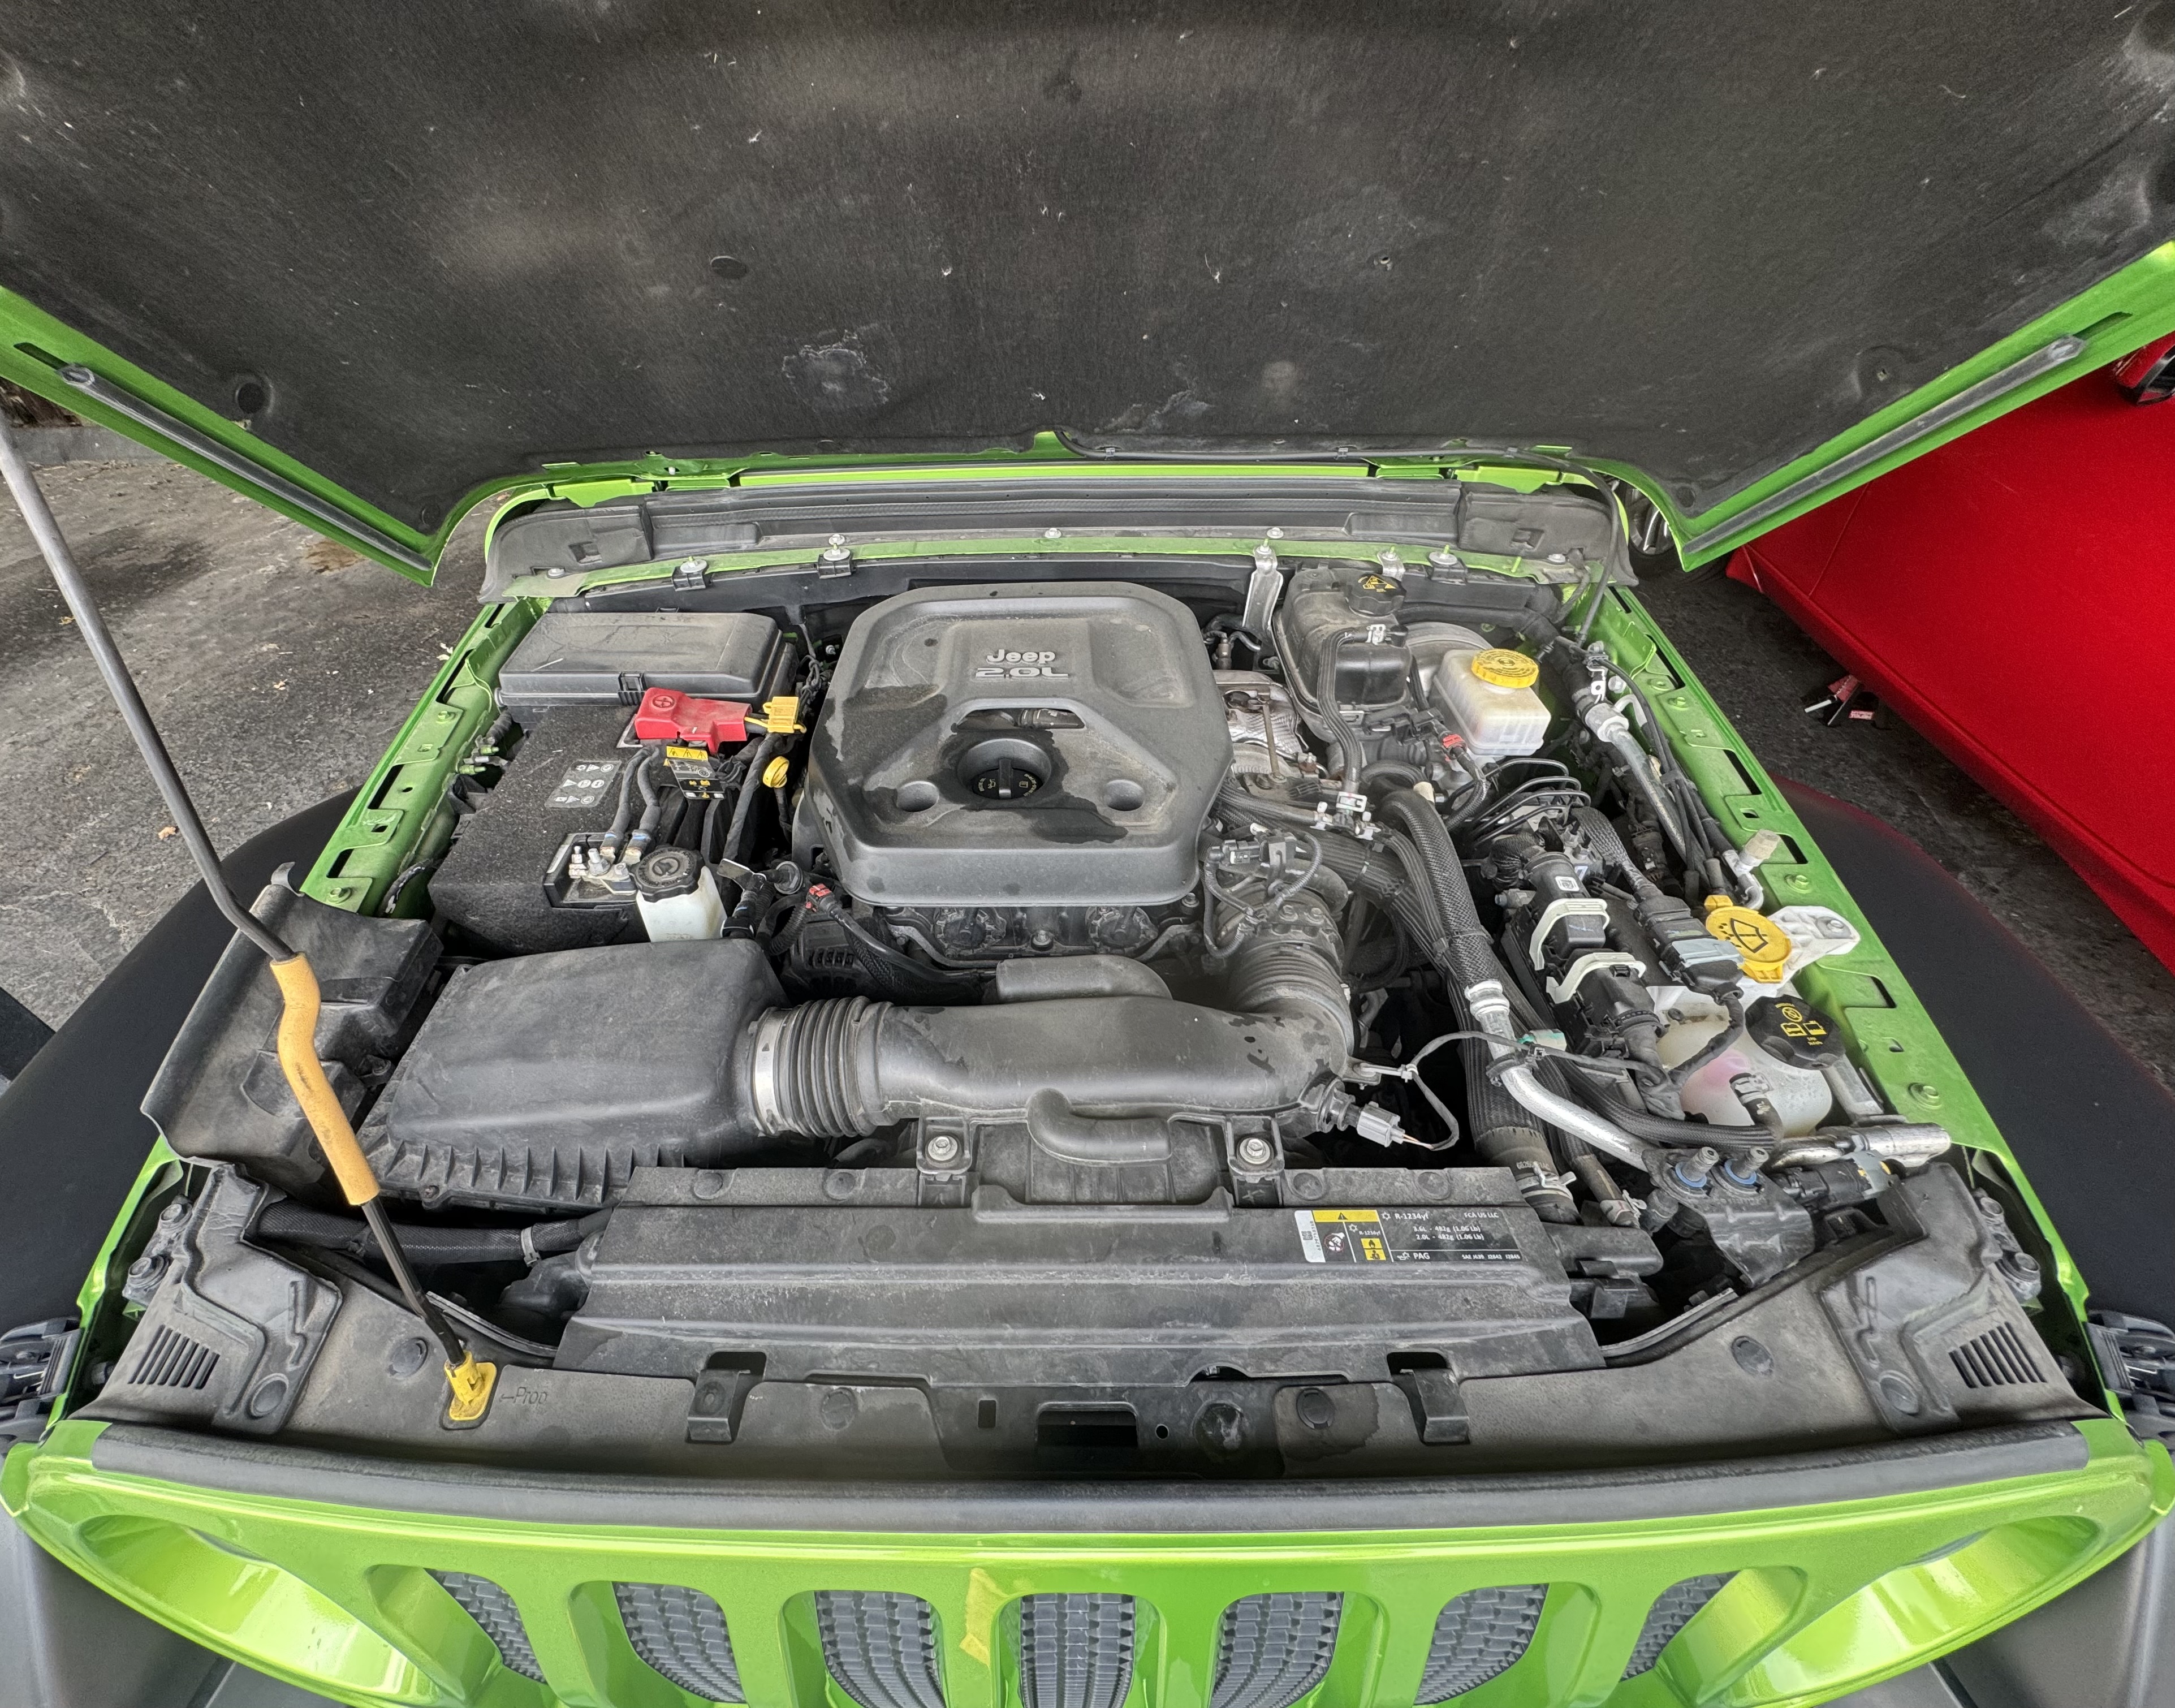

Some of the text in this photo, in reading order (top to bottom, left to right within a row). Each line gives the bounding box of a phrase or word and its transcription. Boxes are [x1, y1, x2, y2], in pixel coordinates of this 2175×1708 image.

[986, 649, 1056, 665] Jeep
[976, 667, 1069, 678] 2.0L
[1395, 1212, 1429, 1220] R-1234yf
